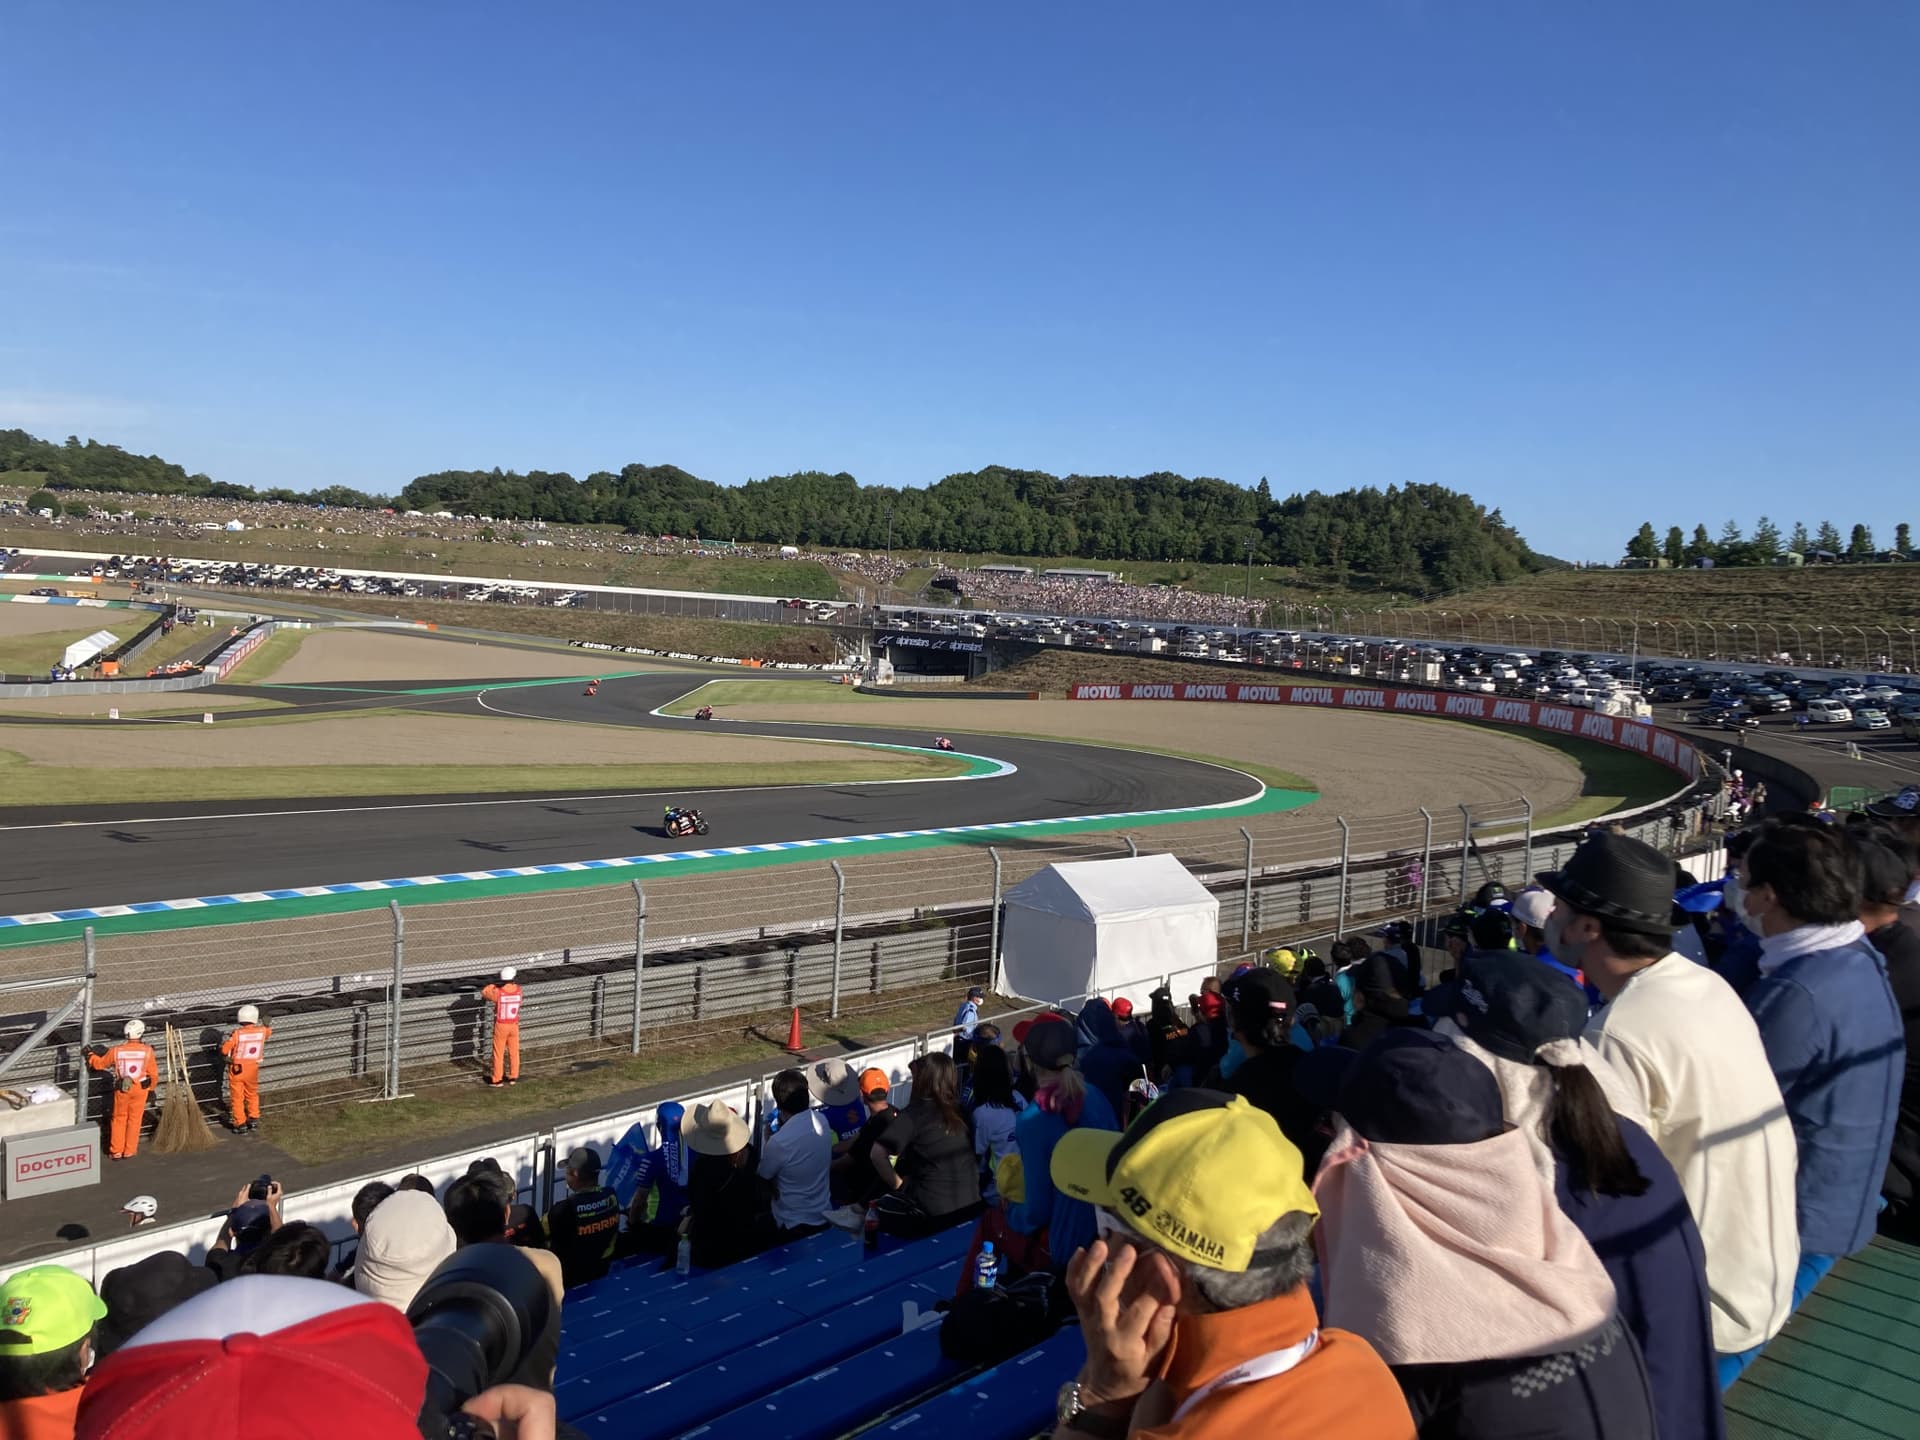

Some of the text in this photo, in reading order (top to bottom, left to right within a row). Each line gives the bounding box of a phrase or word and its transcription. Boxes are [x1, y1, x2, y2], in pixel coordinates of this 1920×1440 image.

[1077, 685, 1121, 699] MOTUL
[1131, 685, 1175, 698] MOTUL
[1184, 685, 1228, 699] MOTUL
[1237, 686, 1280, 701] MOTUL
[1290, 687, 1334, 704] MOTUL
[1342, 689, 1385, 707] MOTUL
[1394, 692, 1437, 711] MOTUL
[1445, 696, 1485, 716] MOTUL
[1492, 701, 1531, 723] MOTUL
[1537, 706, 1575, 731] MOTUL
[1580, 713, 1614, 740] MOTUL
[1620, 722, 1648, 752] MOTUL
[20, 1153, 86, 1174] DOCTOR
[1120, 1186, 1153, 1217] 46
[1170, 1220, 1225, 1260] YAMAHA
